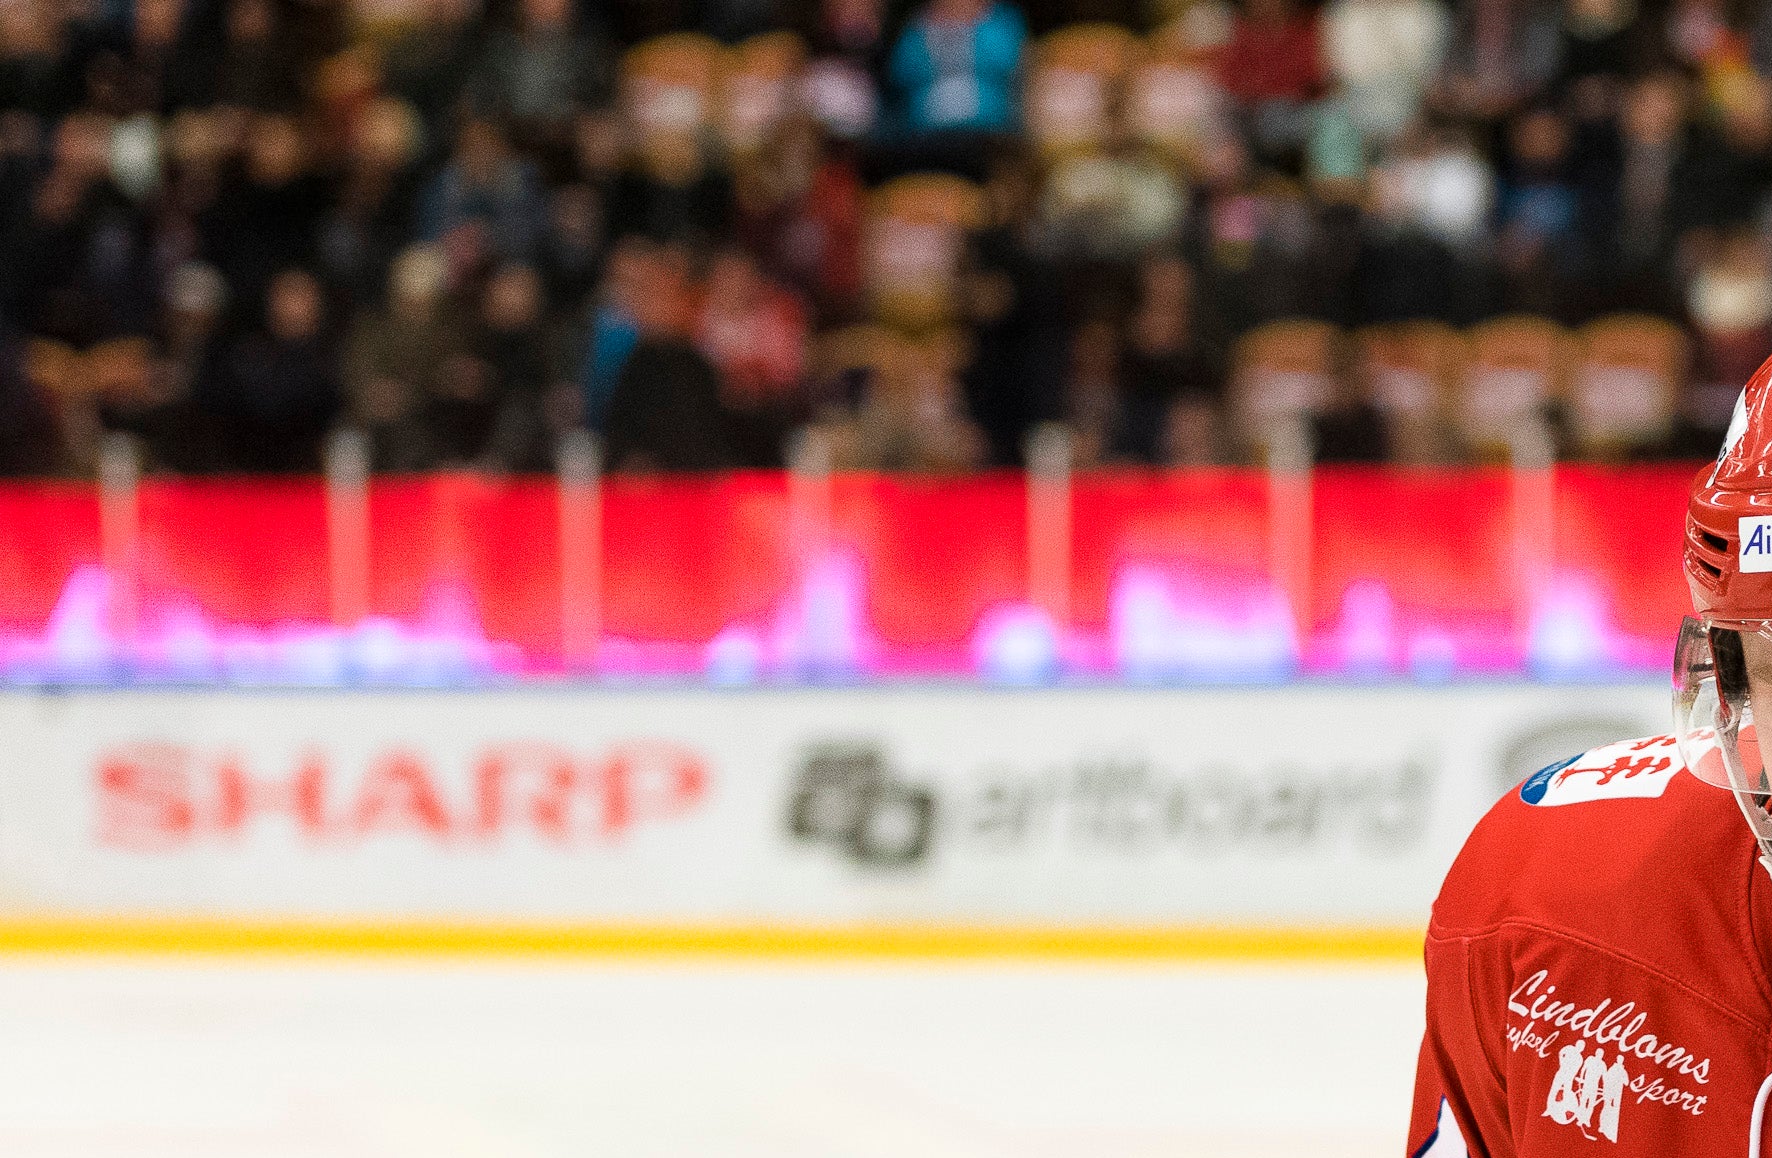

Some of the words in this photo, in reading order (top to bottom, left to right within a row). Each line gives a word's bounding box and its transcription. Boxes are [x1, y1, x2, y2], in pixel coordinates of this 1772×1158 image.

[92, 740, 712, 851] SHARP
[1506, 1020, 1560, 1059] ykel
[1629, 1073, 1708, 1116] sport
[1507, 969, 1711, 1085] Lindbloms
